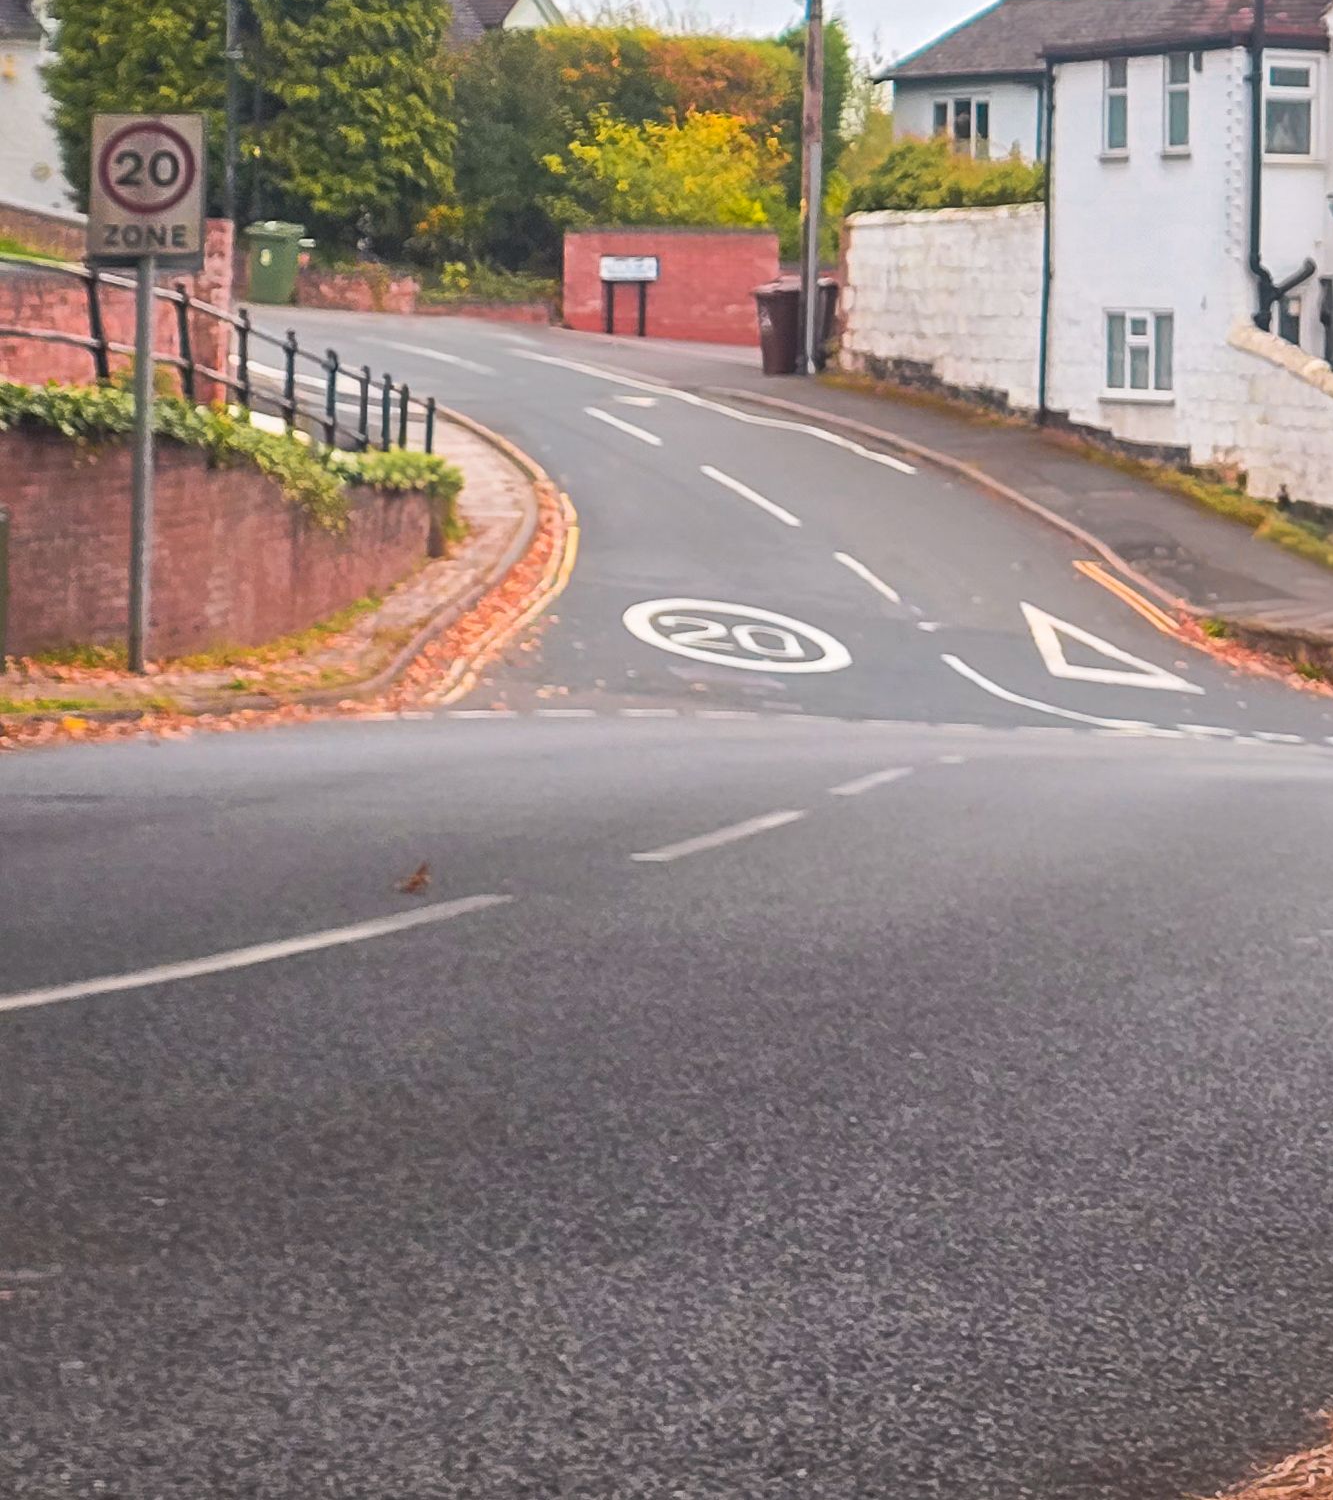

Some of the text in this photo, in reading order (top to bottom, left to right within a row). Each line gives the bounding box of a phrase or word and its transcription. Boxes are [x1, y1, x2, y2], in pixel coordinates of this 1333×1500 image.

[115, 150, 180, 187] 20
[103, 224, 187, 248] ZONE
[657, 615, 805, 657] 20
